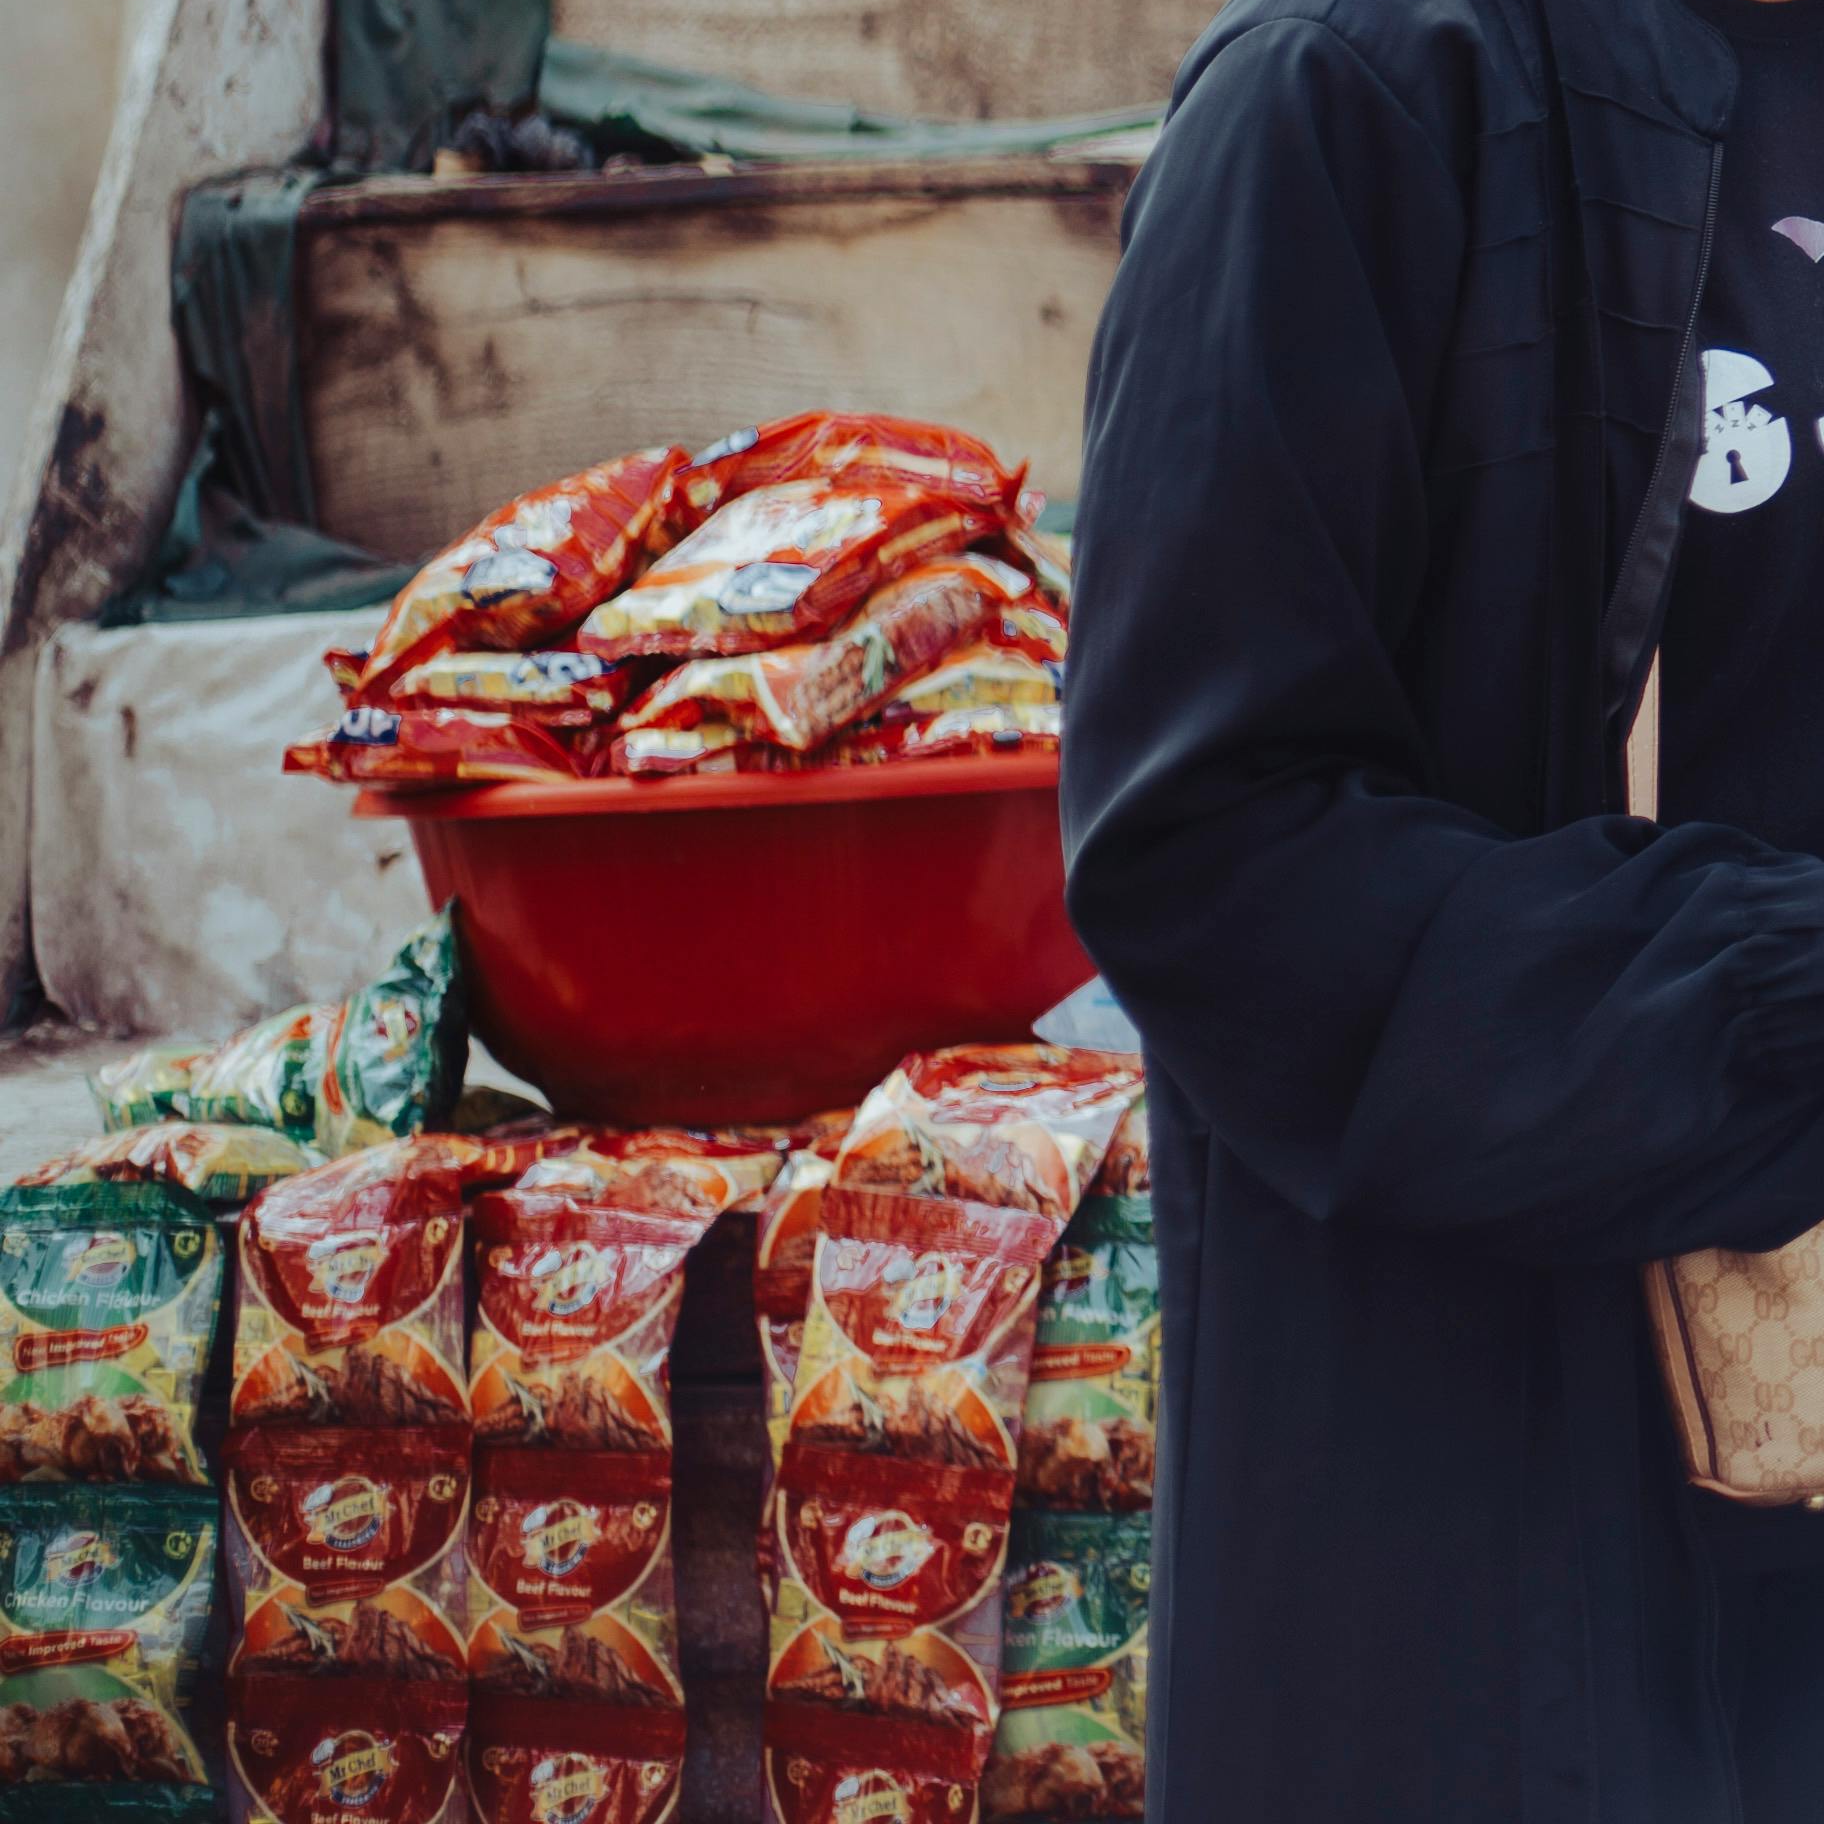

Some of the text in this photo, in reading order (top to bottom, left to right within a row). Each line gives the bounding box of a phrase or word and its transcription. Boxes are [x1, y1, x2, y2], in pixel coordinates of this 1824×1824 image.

[17, 1289, 162, 1309] Chicken Flavour
[302, 1303, 328, 1318] Beef
[49, 1337, 106, 1357] Improved
[303, 1556, 385, 1571] Beef Flavour
[516, 1579, 592, 1597] Beef Flavour
[839, 1587, 869, 1606] Beef
[4, 1592, 150, 1612] Chicken Flavour
[28, 1638, 87, 1657] Improved
[88, 1634, 123, 1646] Taste
[1041, 1627, 1122, 1649] Flavour
[330, 1753, 376, 1780] Mr Chef
